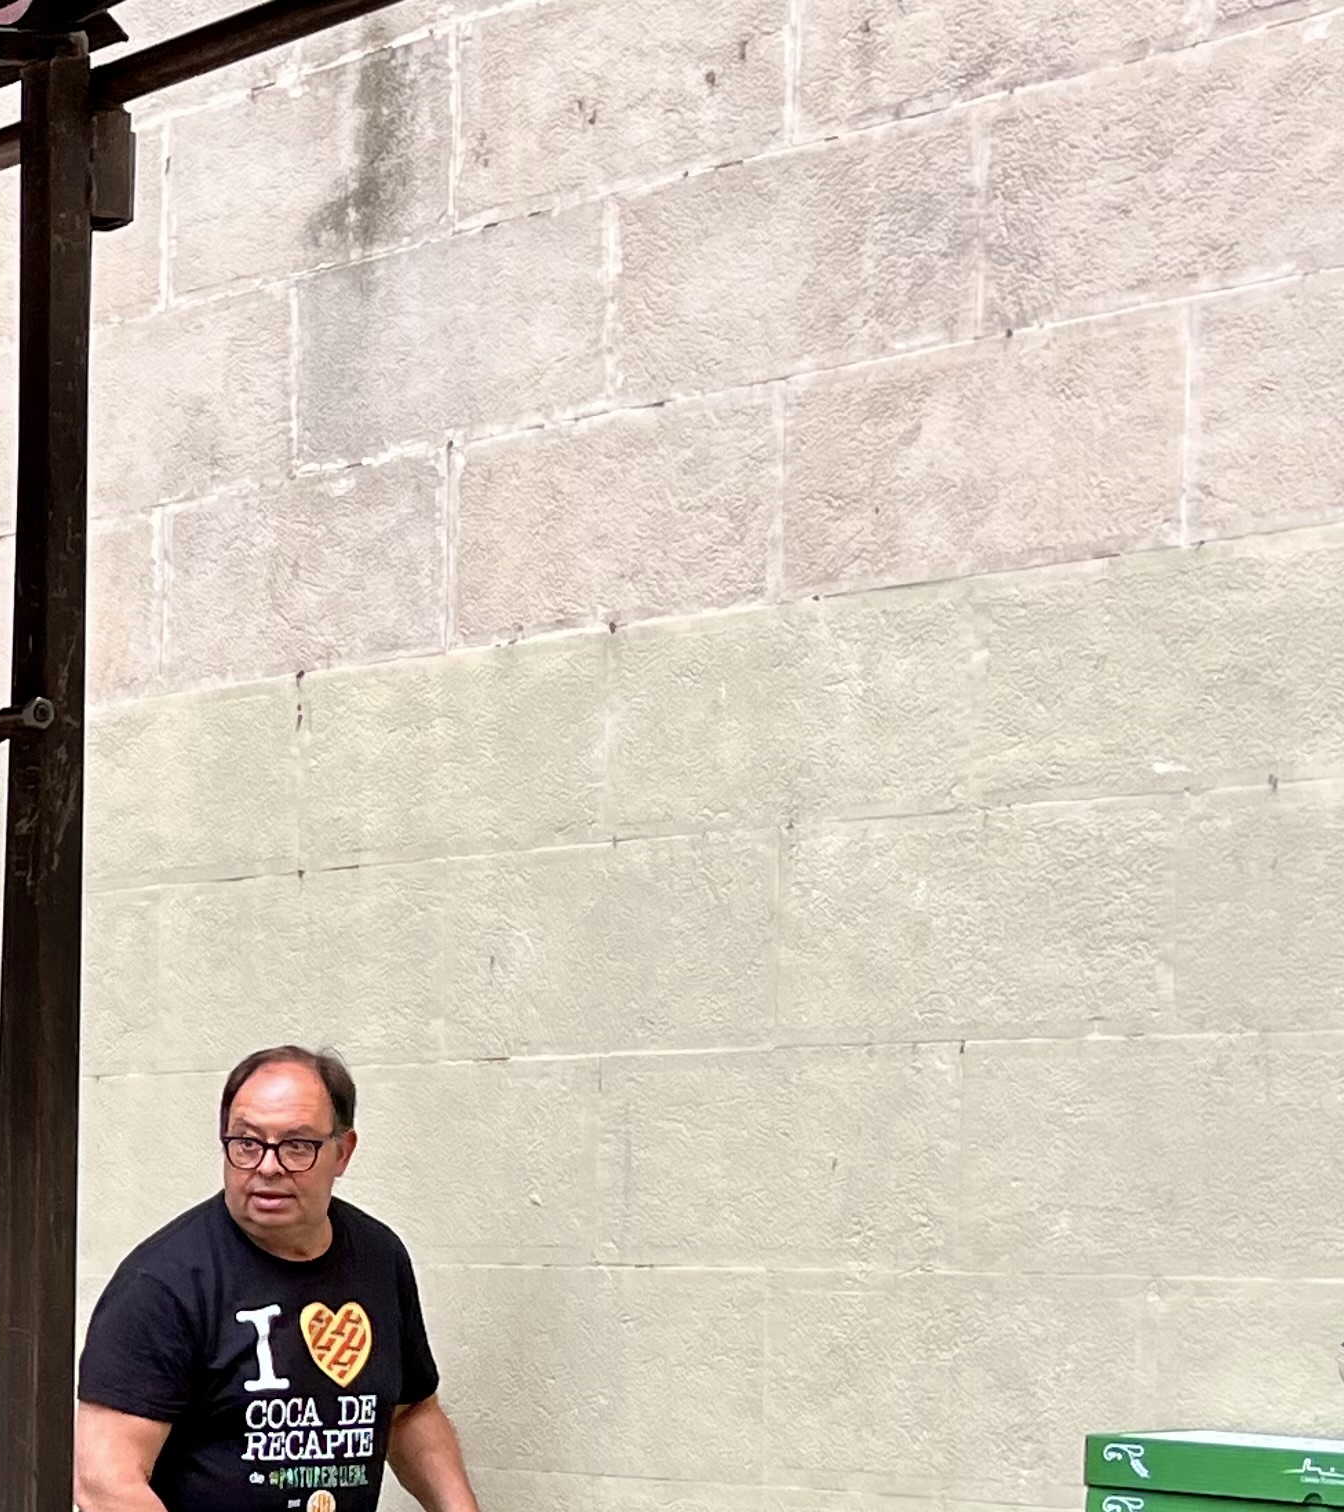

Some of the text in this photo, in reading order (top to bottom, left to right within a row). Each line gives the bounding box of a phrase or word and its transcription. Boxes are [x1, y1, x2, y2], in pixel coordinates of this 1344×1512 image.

[236, 1303, 290, 1392] I
[246, 1395, 377, 1429] COCA DE
[241, 1428, 374, 1460] RECAPTE
